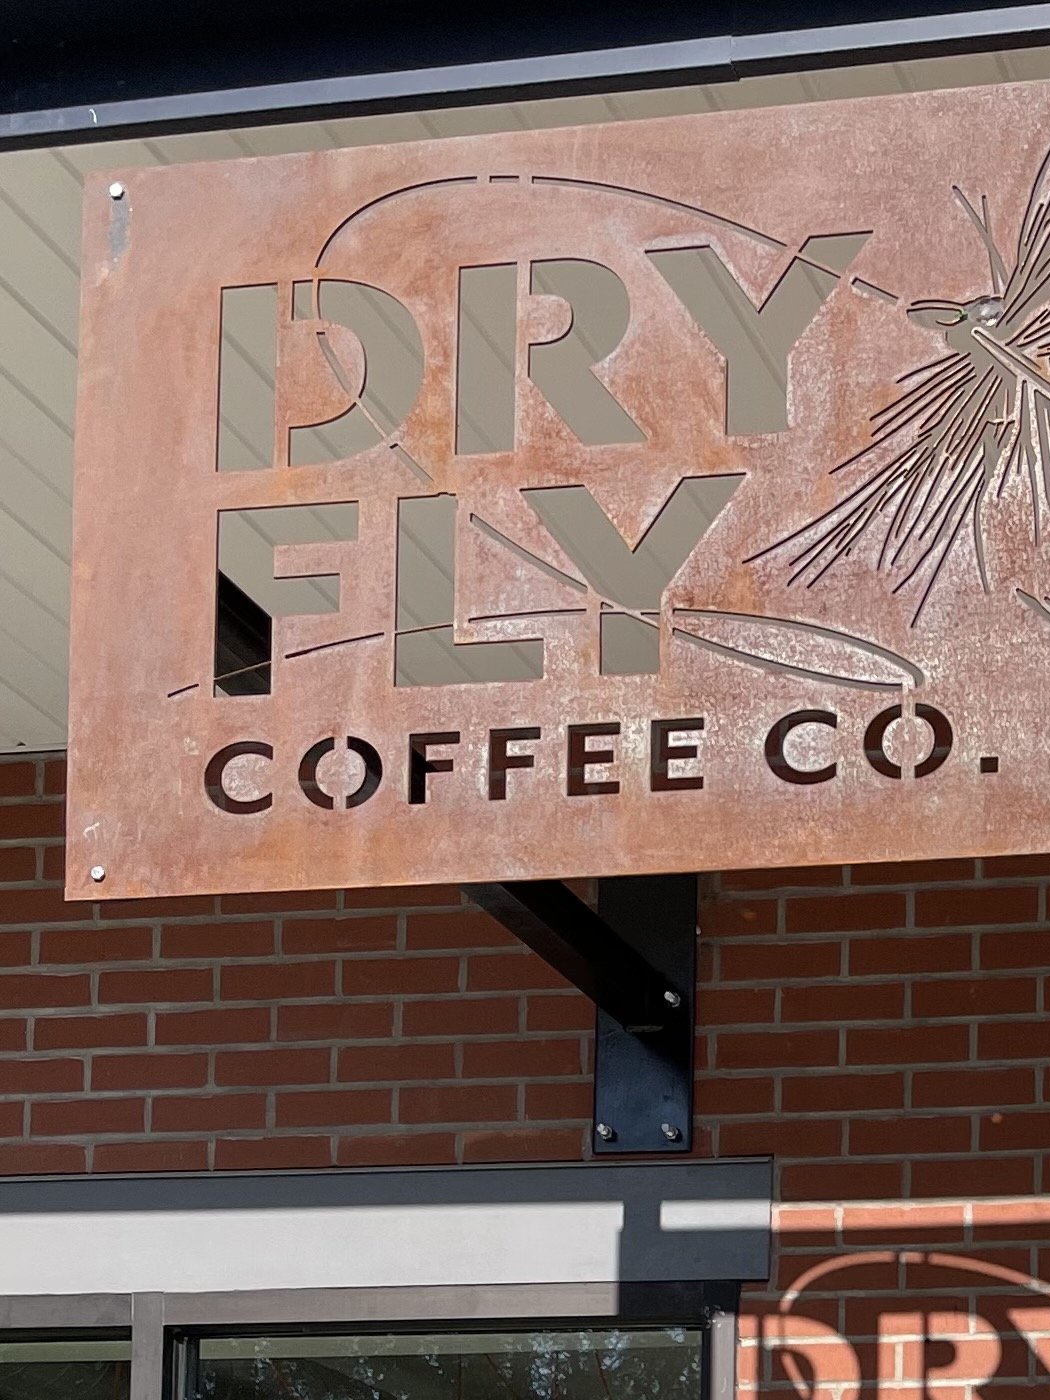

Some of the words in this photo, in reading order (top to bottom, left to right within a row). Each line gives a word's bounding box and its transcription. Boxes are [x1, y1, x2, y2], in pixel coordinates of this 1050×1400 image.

[215, 230, 874, 473] DRY
[212, 472, 747, 698] FLY
[203, 716, 706, 816] COFFEE
[763, 702, 1000, 786] CO.
